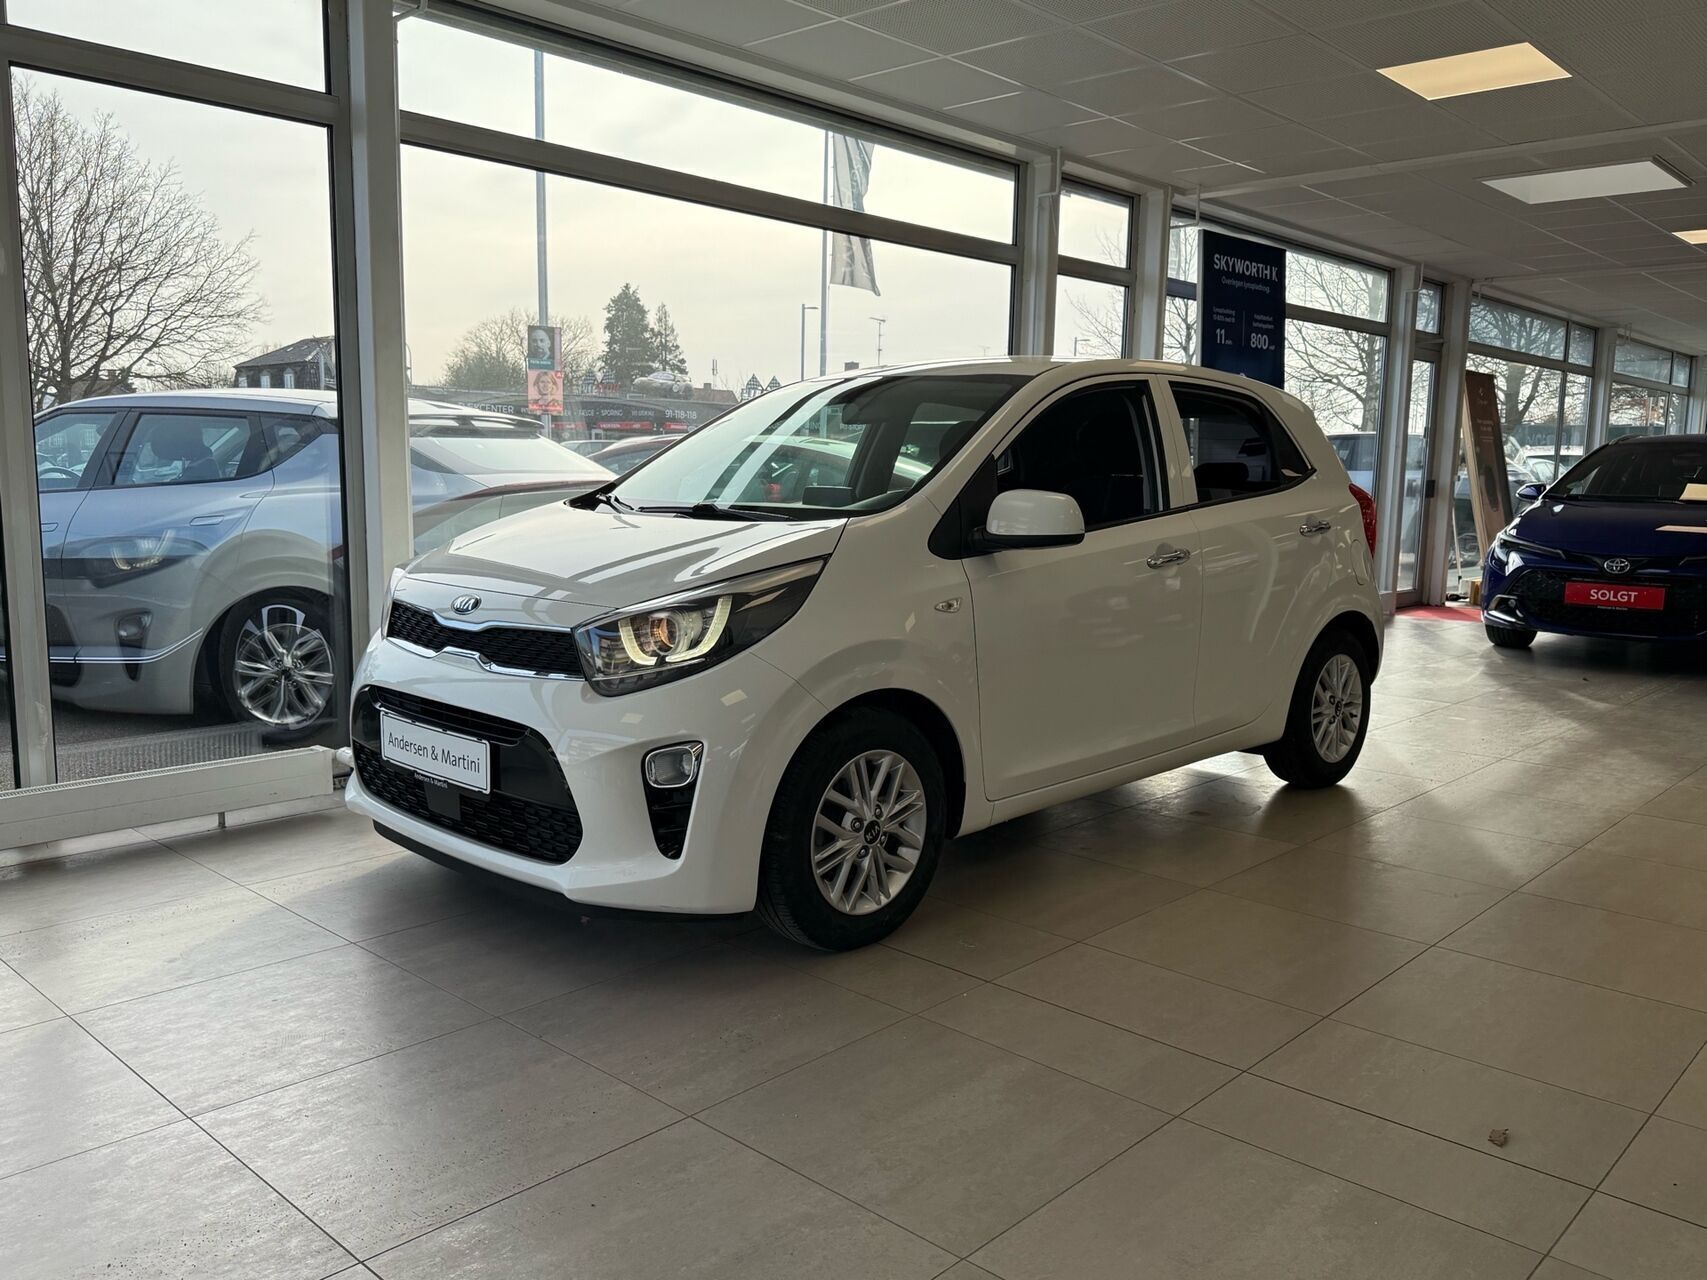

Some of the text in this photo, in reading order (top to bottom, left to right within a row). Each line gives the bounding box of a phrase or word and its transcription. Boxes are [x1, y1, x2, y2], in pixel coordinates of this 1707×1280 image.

[1213, 253, 1279, 282] SKYWORTH K
[1215, 328, 1225, 344] 11
[1250, 332, 1269, 350] 800
[664, 408, 697, 419] 91-118-118
[1590, 589, 1638, 603] SOLGT
[388, 732, 480, 774] Andersen & Martini
